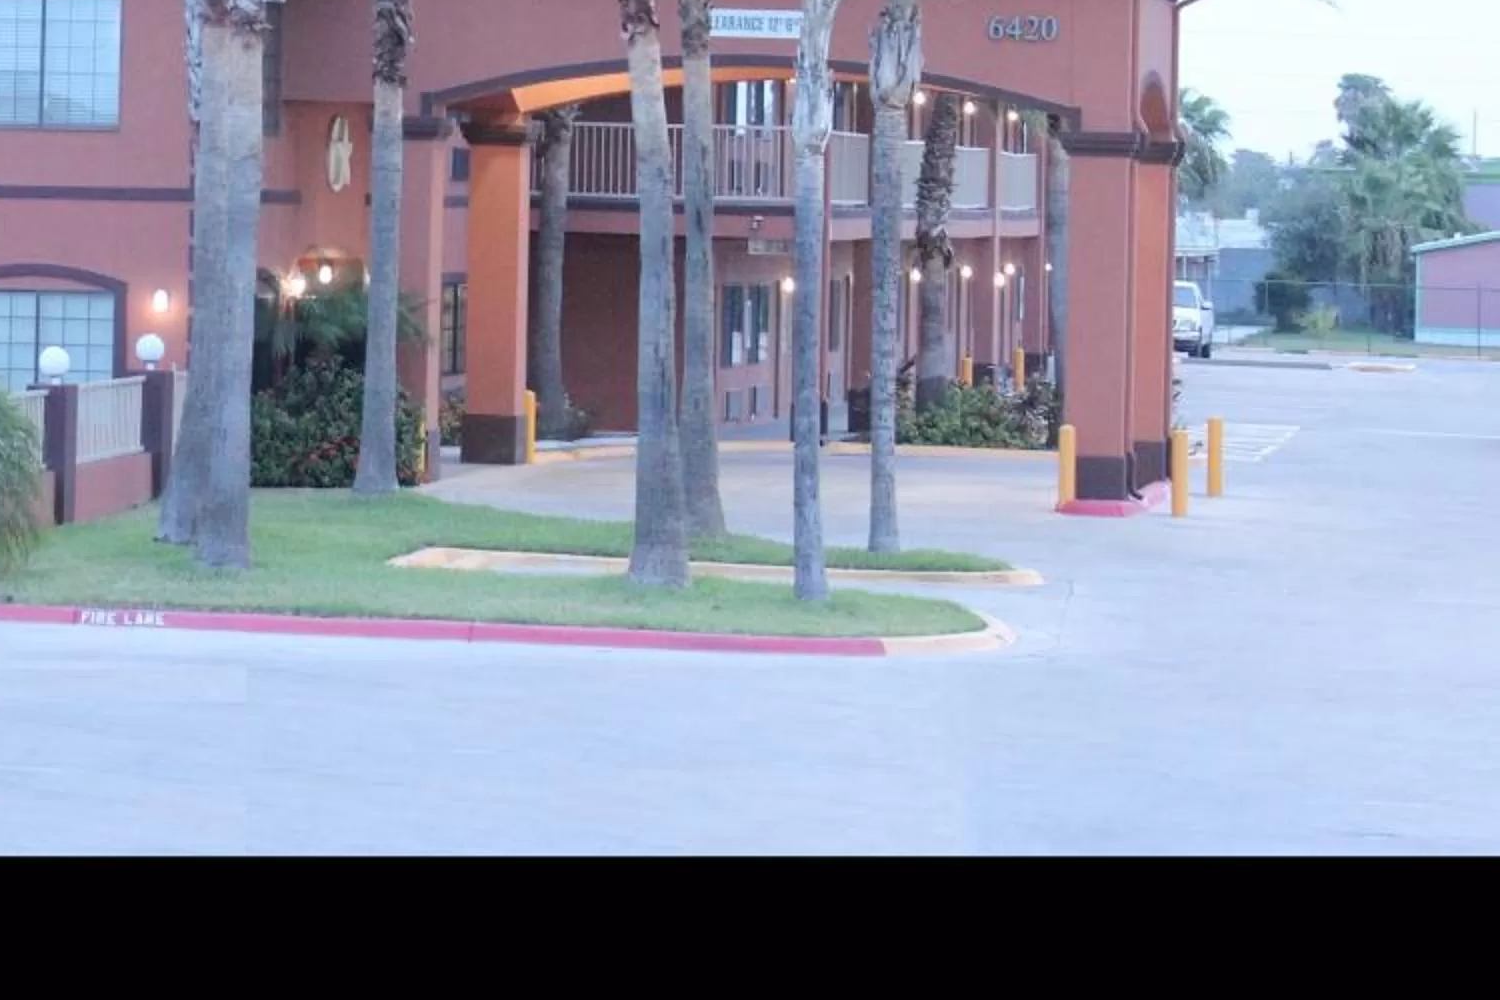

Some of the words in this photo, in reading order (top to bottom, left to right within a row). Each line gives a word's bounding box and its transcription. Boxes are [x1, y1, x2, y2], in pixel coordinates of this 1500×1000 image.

[708, 15, 764, 31] EARANCE
[988, 15, 1058, 41] 6420
[81, 610, 116, 625] FIRE
[123, 610, 164, 626] LANE
